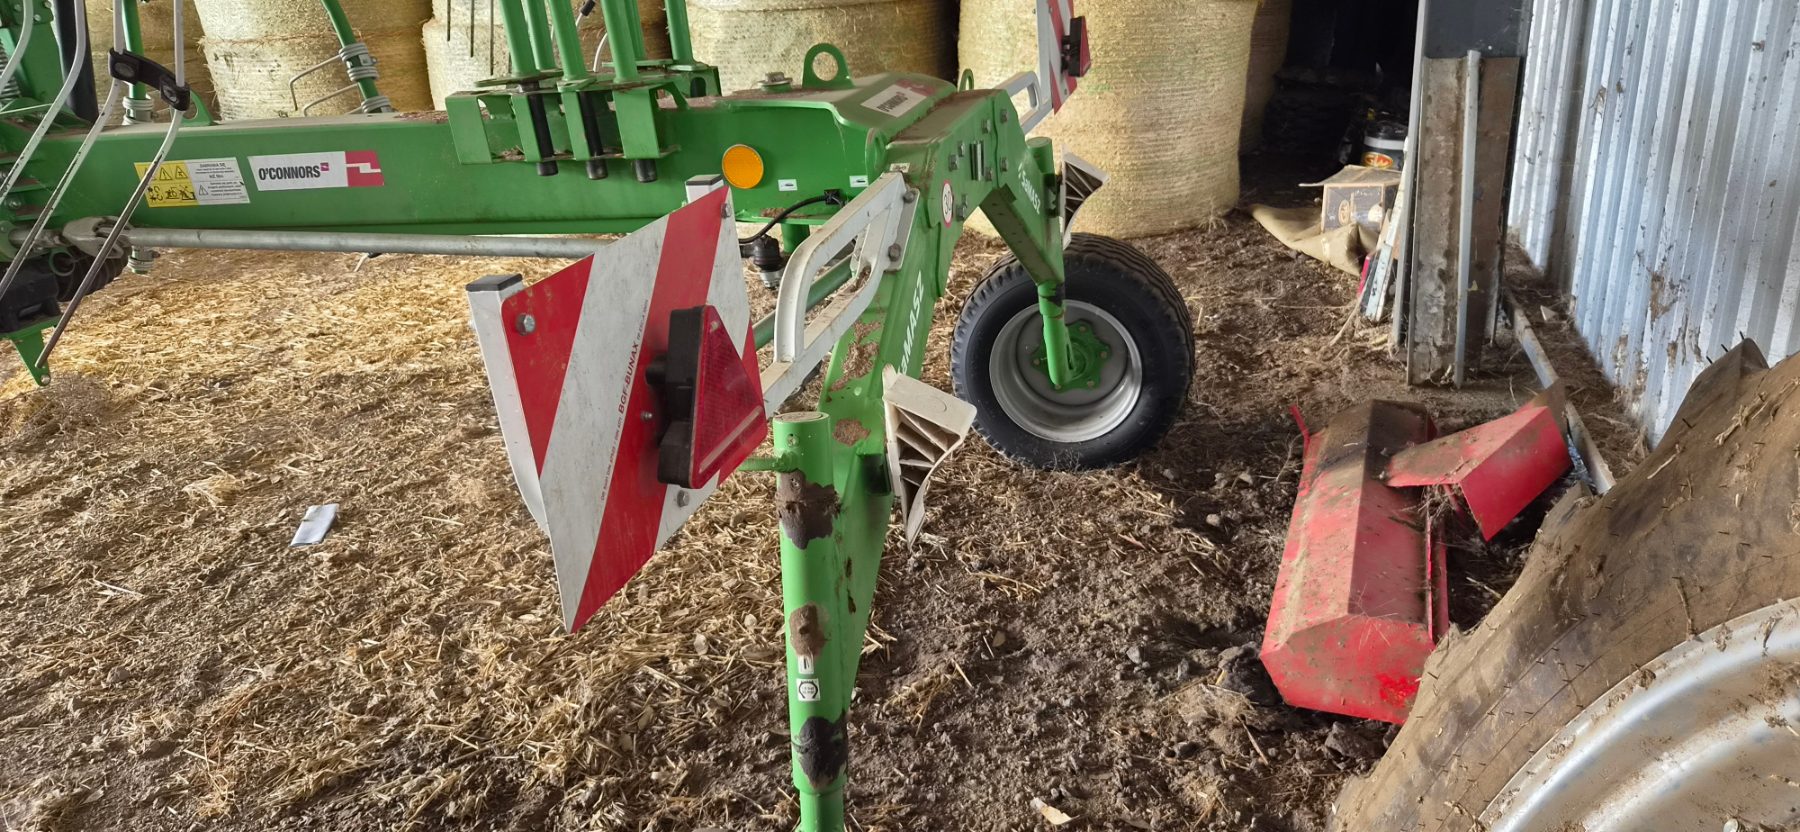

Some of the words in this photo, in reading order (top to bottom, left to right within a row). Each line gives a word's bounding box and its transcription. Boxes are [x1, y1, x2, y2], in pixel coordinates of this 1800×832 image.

[259, 165, 321, 181] O'CONNORS
[943, 190, 952, 215] 30
[618, 341, 639, 414] BGF-BUNAX
